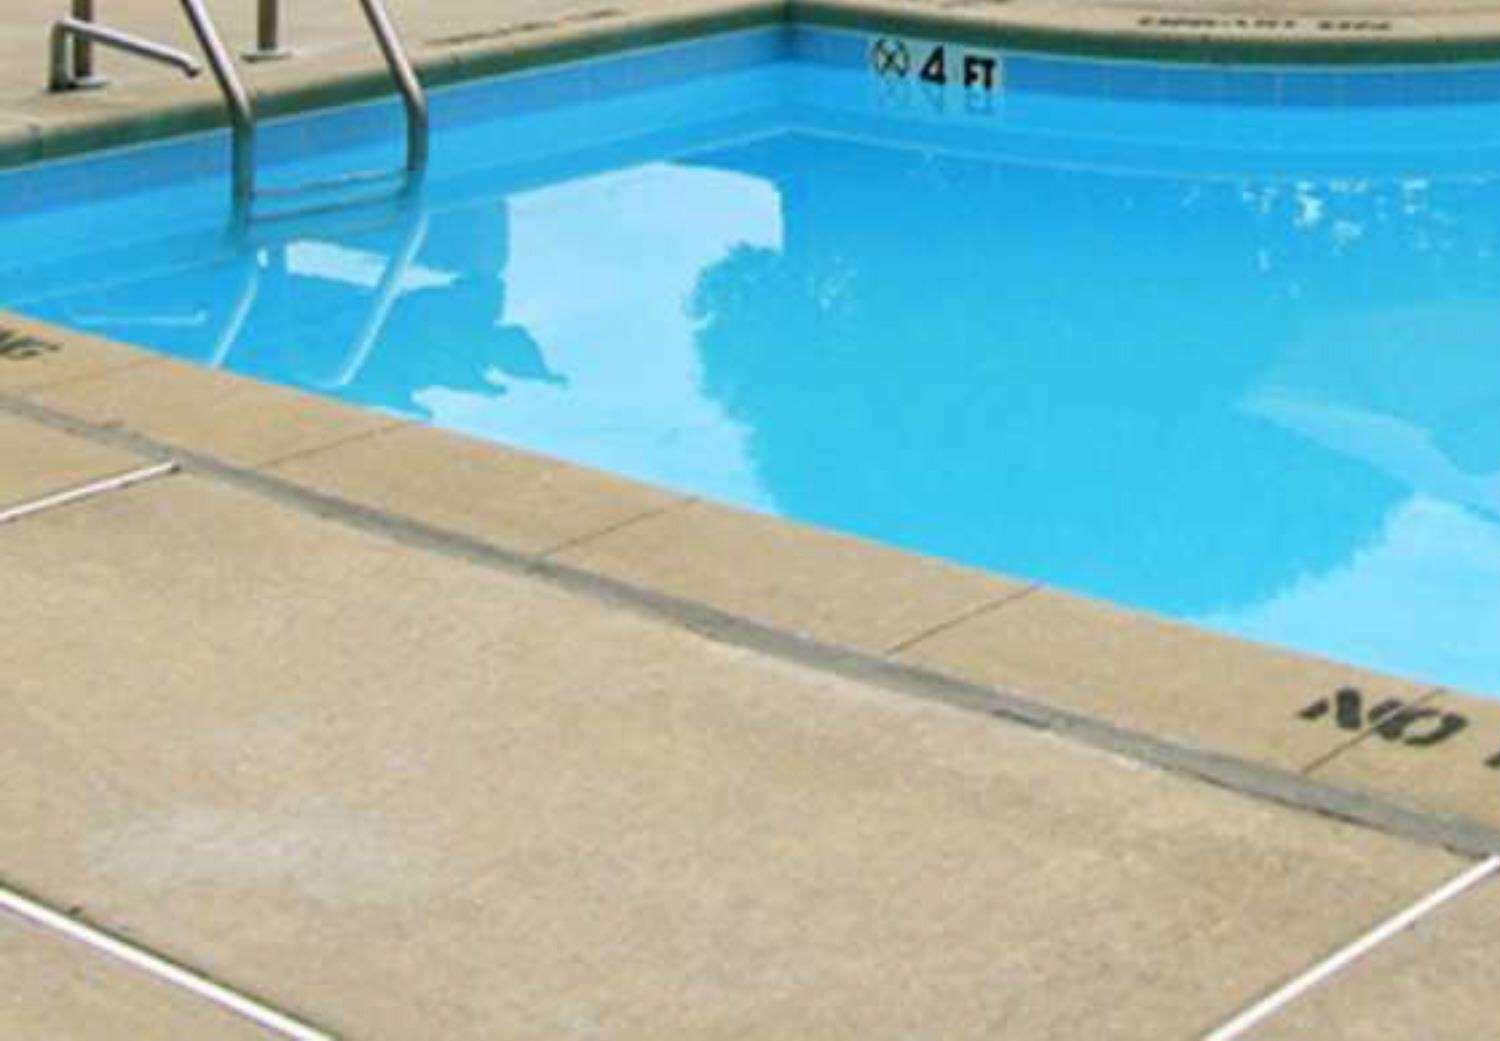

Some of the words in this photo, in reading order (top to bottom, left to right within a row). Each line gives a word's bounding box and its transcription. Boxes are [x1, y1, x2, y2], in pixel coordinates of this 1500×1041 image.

[919, 45, 946, 84] 4
[963, 54, 996, 90] FT
[1299, 687, 1468, 747] NO
